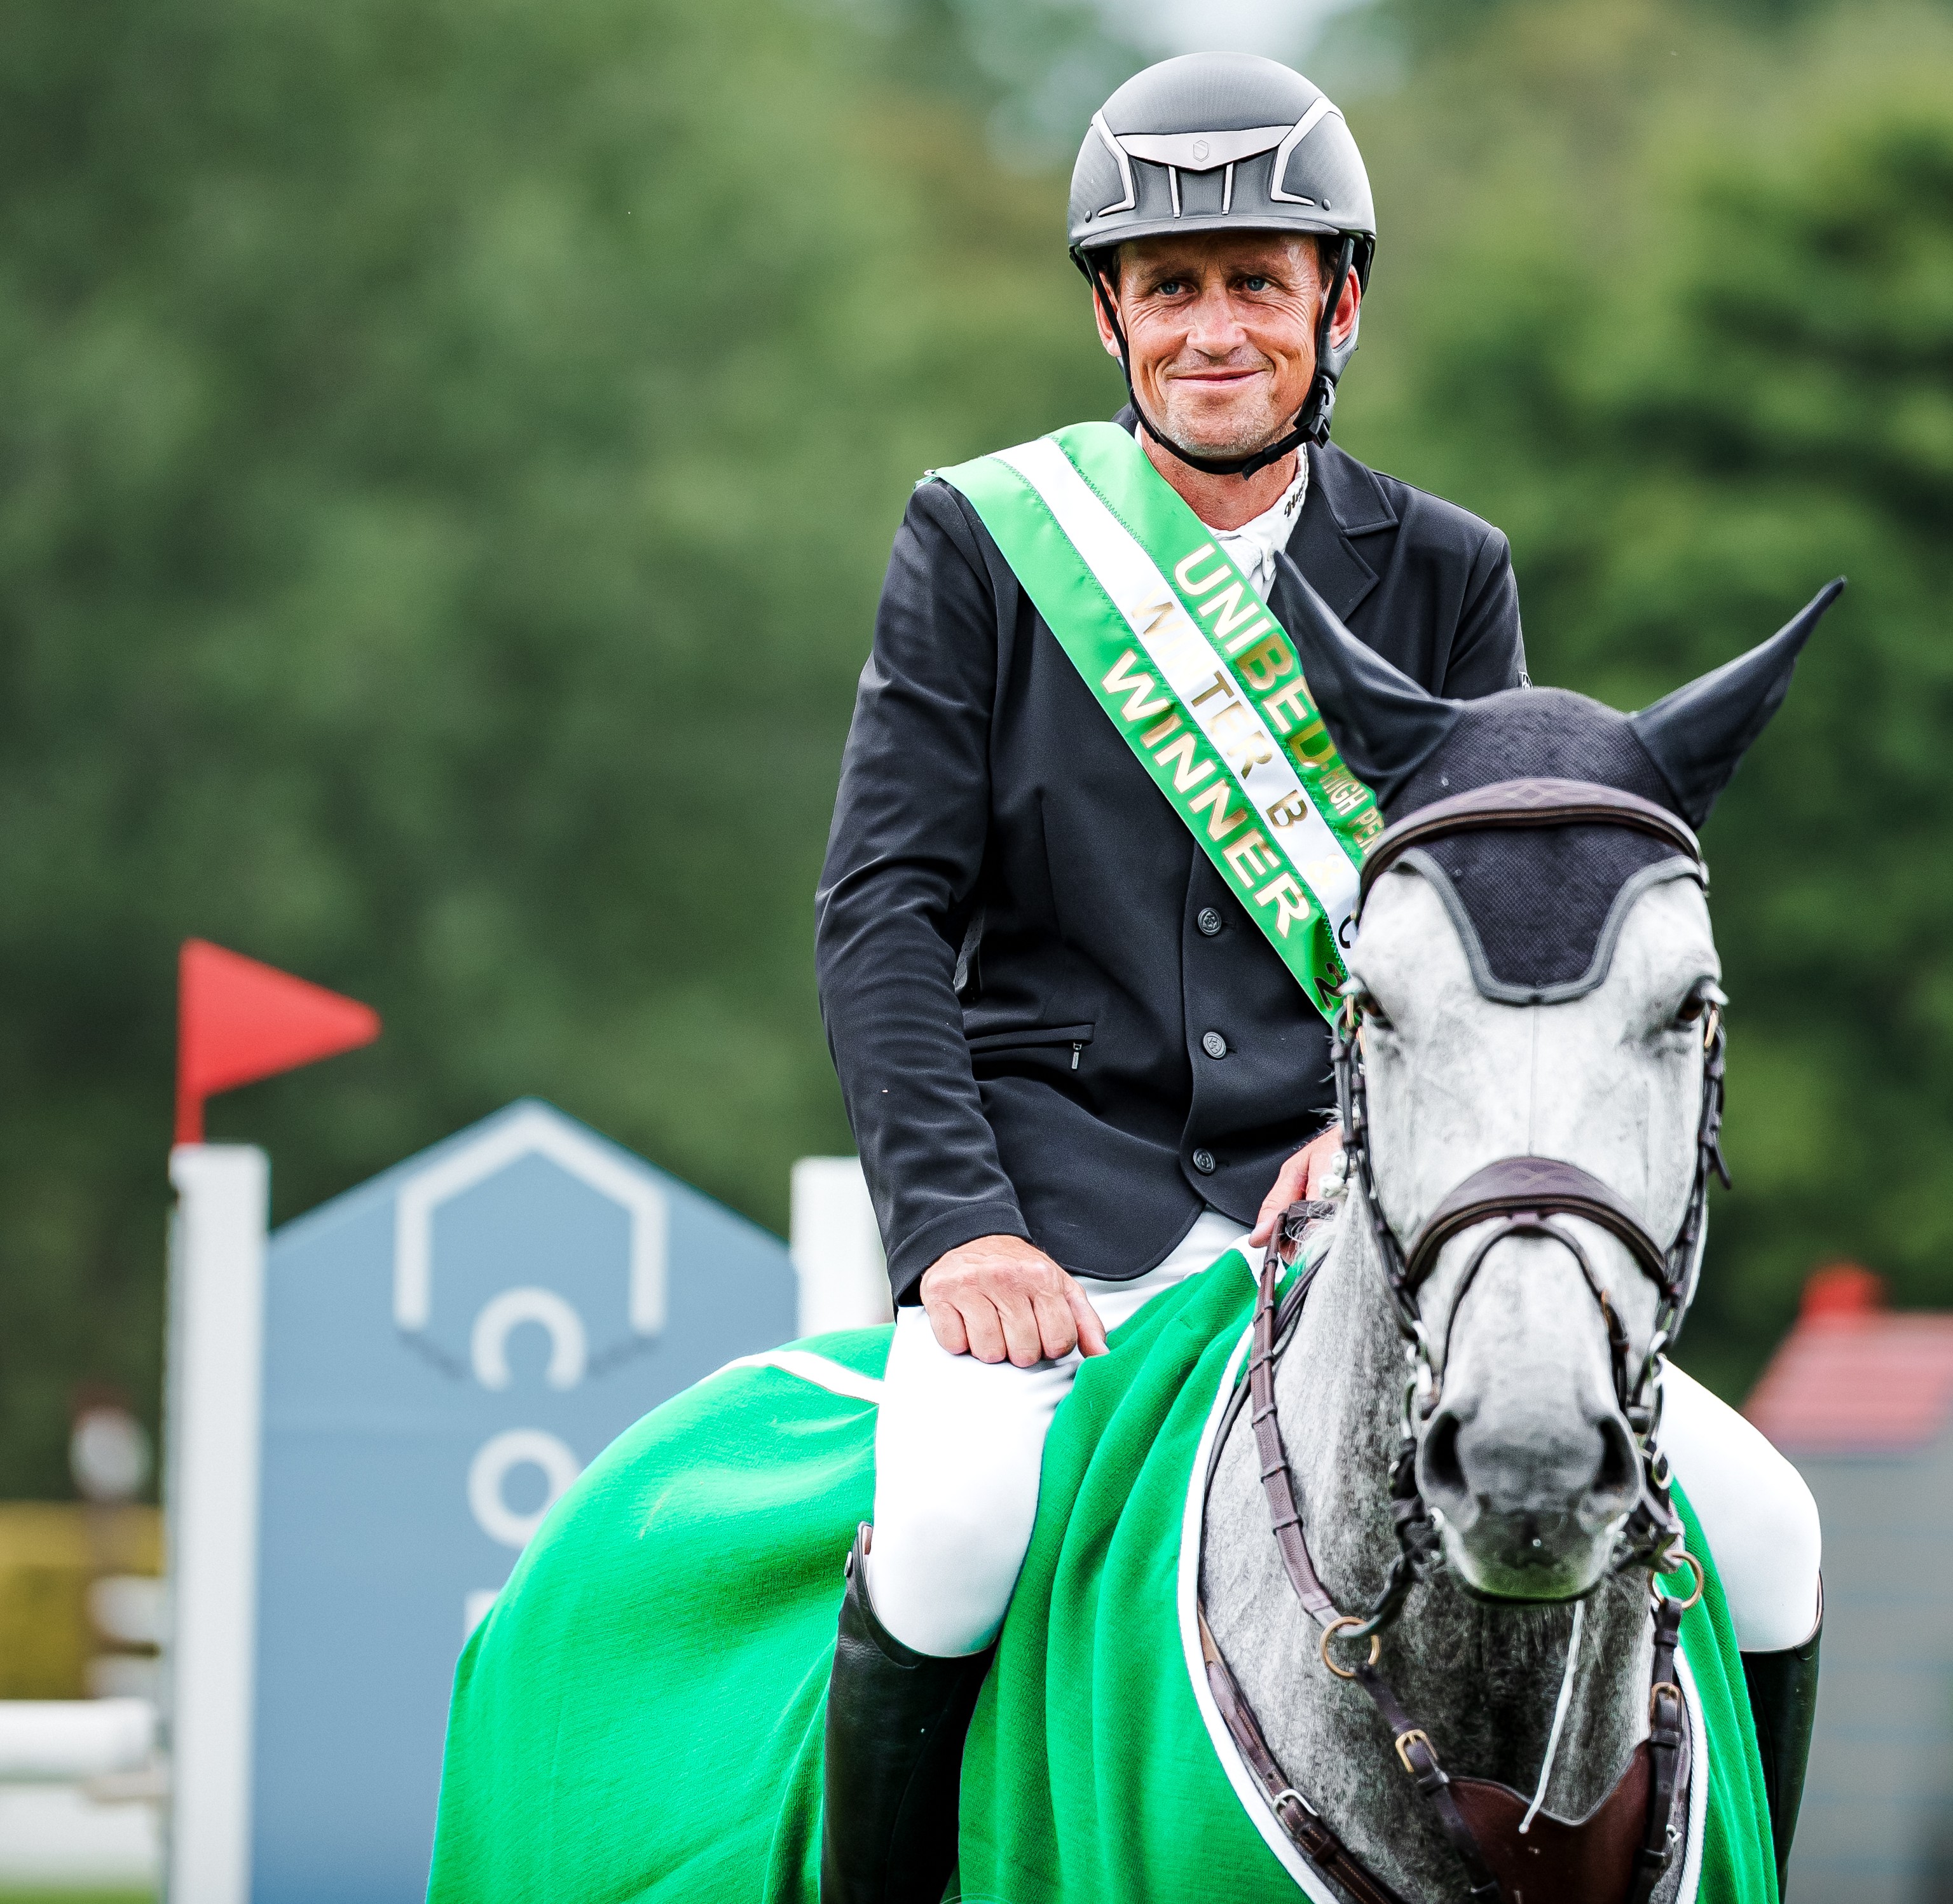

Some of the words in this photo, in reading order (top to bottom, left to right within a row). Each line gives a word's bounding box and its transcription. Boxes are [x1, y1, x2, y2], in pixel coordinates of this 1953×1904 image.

[1100, 648, 1311, 938] WINNER
[1131, 586, 1273, 780] WINTER
[1266, 789, 1308, 833] B
[1174, 542, 1337, 768] UNIBED
[1319, 763, 1369, 817] HIGH
